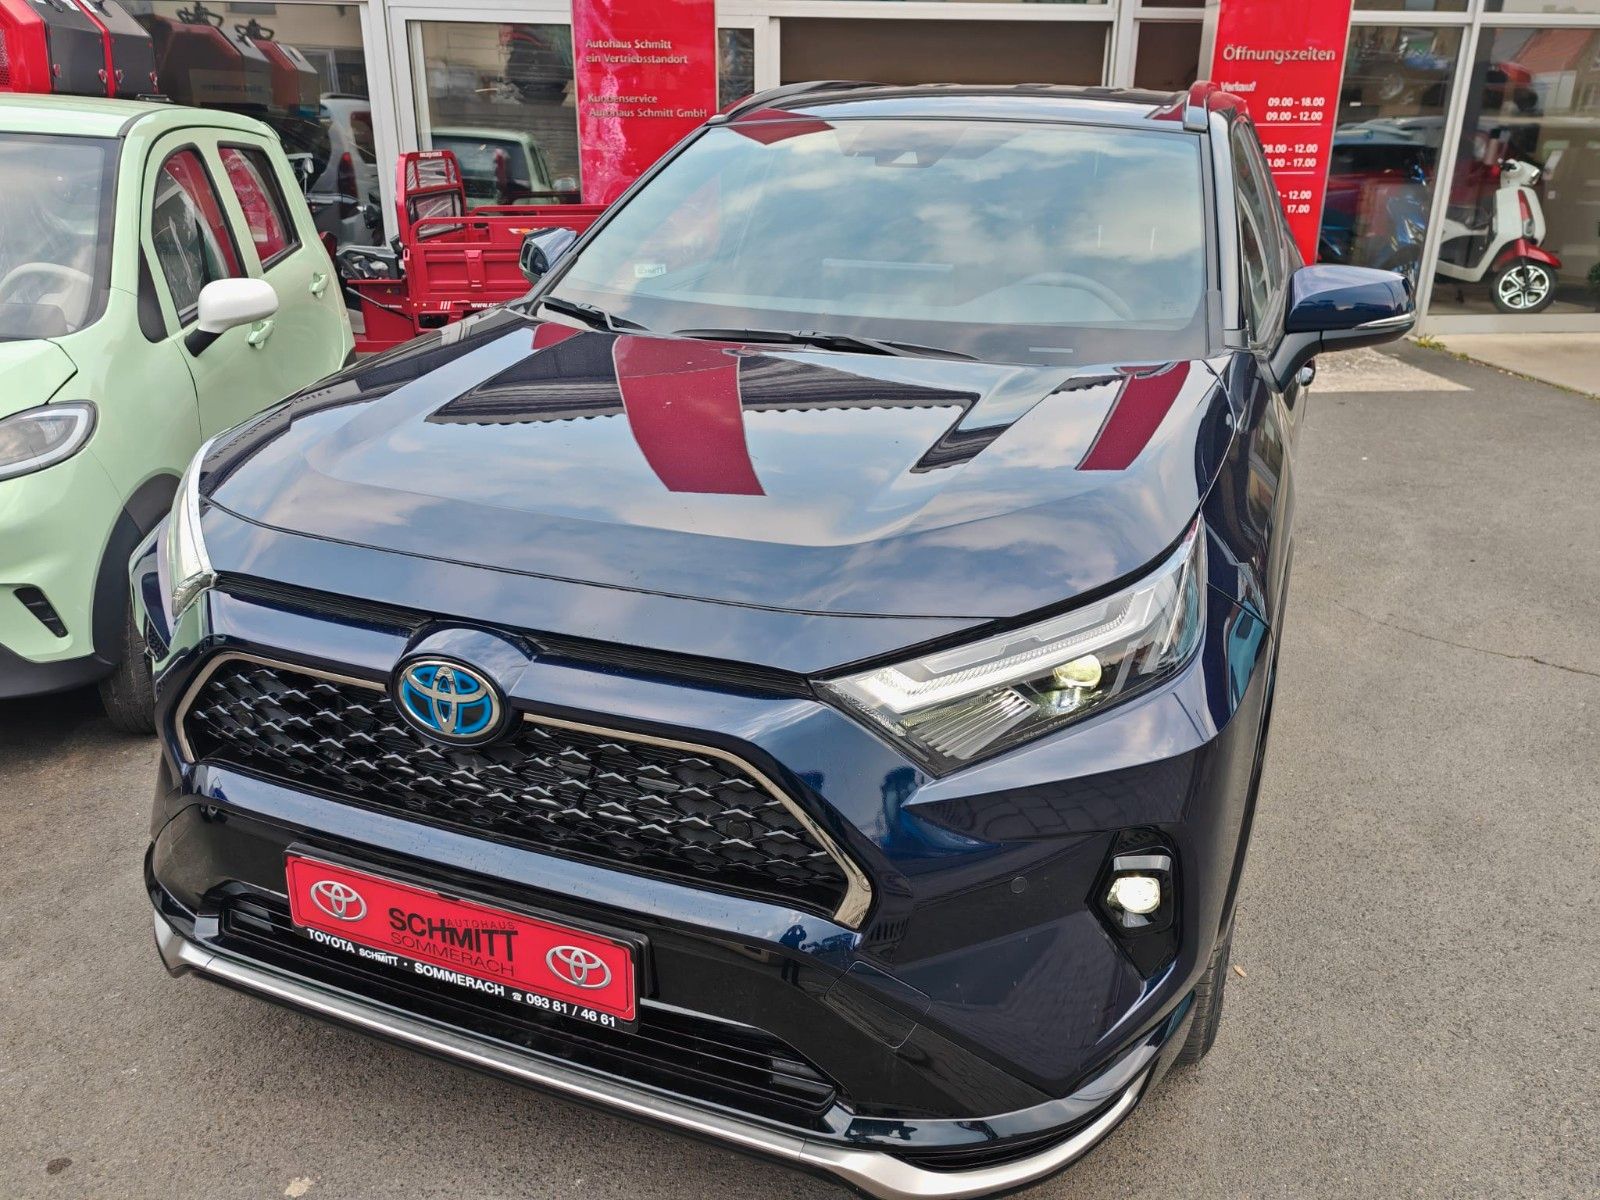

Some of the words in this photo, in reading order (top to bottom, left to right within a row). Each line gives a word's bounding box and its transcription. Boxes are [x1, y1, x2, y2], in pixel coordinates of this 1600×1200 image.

[585, 39, 631, 49] Autohaus
[634, 39, 672, 49] Schmitt
[585, 54, 601, 63] ein
[604, 54, 688, 64] Vertriebsstandort
[1222, 44, 1336, 64] Öffnungszeiten
[587, 94, 658, 104] Kundenservice
[1268, 97, 1293, 107] 09.00
[1301, 97, 1325, 107] 18.00
[589, 109, 634, 118] Autohaus
[637, 108, 673, 118] Schmitt
[676, 109, 707, 118] GmbH
[1266, 111, 1291, 121] 09.00
[1299, 111, 1323, 121] 12.00
[1294, 144, 1318, 154] 12.00
[1293, 158, 1317, 168] 17.00
[1288, 190, 1312, 200] 12.00
[1287, 204, 1310, 214] 17.00
[447, 917, 516, 930] AUTOHAUS
[388, 906, 519, 961] SCHMITT
[391, 931, 515, 977] SOMMERACH
[306, 927, 355, 954] TOYOTA
[358, 947, 398, 967] SCHMITT
[414, 962, 505, 997] SOMMERACH
[525, 993, 550, 1009] 093
[552, 1000, 568, 1015] 81
[580, 1007, 598, 1023] 46
[600, 1012, 616, 1028] 61
